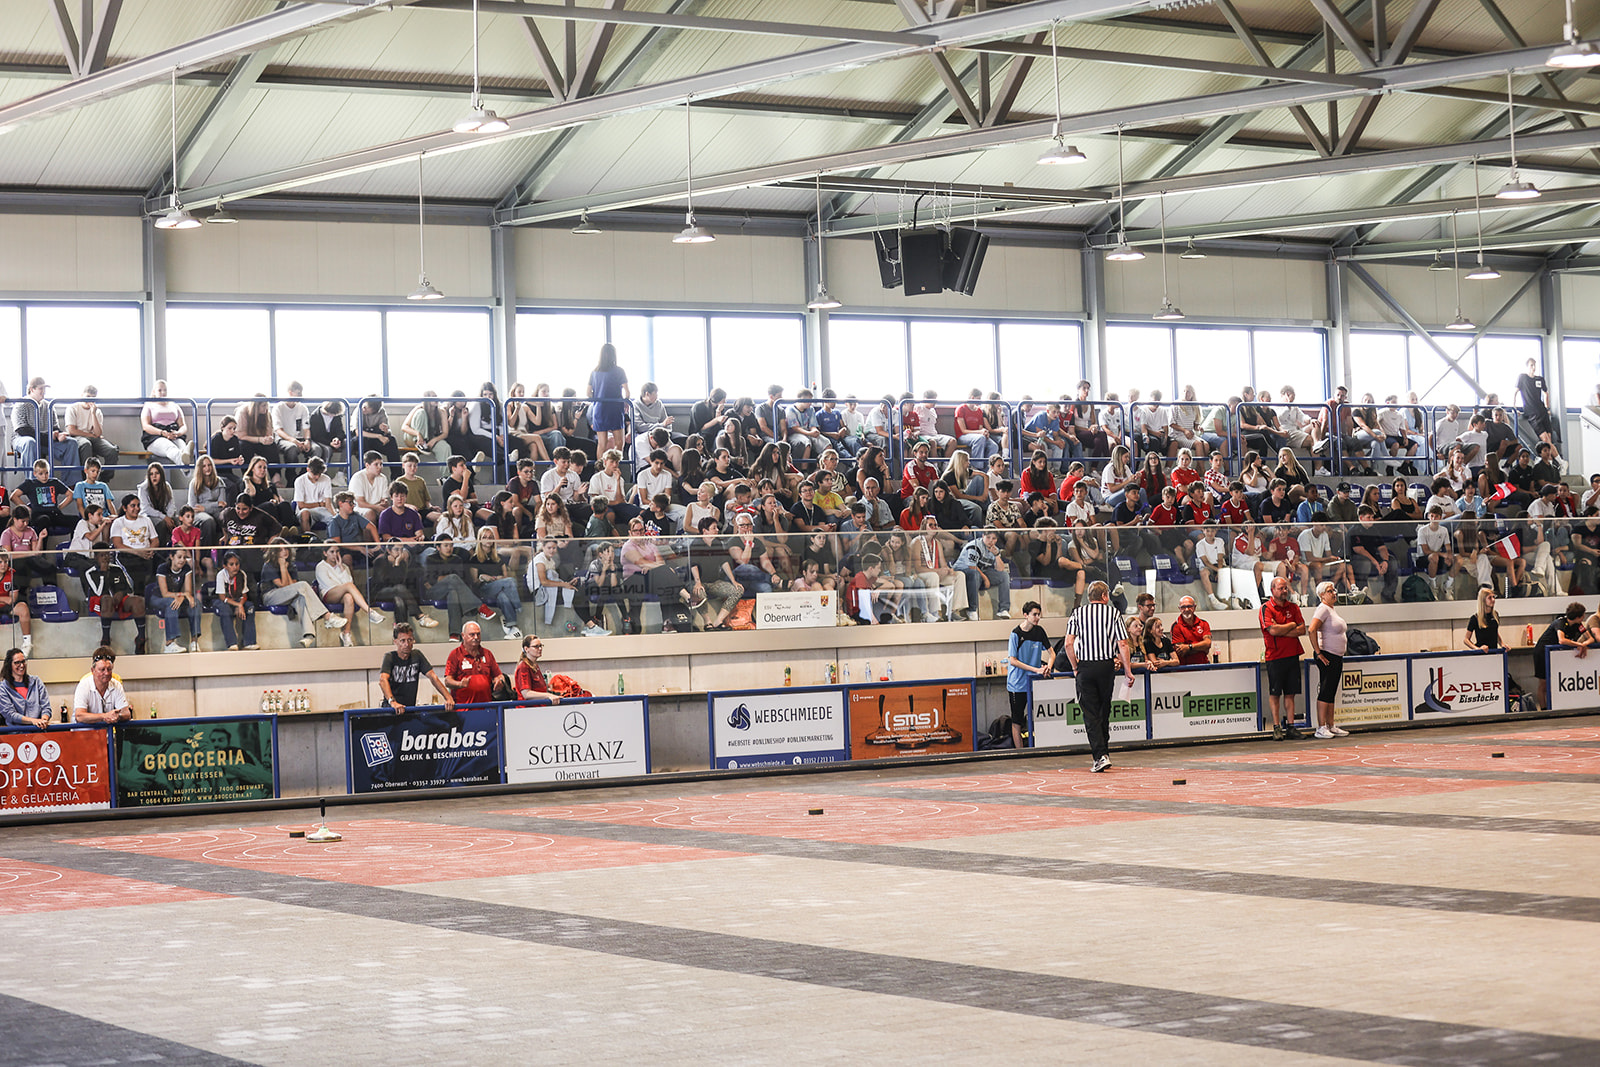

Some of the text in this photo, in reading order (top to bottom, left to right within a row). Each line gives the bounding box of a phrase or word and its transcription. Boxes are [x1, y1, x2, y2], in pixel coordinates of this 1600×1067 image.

[764, 613, 802, 623] Oberwart
[1344, 674, 1360, 687] RM
[1363, 678, 1395, 689] concept
[1558, 670, 1597, 692] kabel
[1154, 695, 1181, 710] ALU
[1188, 696, 1251, 713] PFEIFFER
[754, 706, 833, 724] WEBSCHMIEDE
[1036, 703, 1064, 718] ALU
[1073, 703, 1140, 721] PFER
[400, 727, 487, 752] barabas
[728, 734, 834, 747] #WEBSITE #ONLINESHOP #ONLINEMARKETING
[144, 749, 245, 770] GROCCERIA
[433, 749, 488, 759] BESCHRIFTUNGEN
[528, 740, 624, 765] SCHRANZ
[168, 771, 223, 781] DELIKATESSEN
[555, 769, 600, 781] Oberwart
[11, 795, 18, 804] &
[22, 792, 80, 804] GELATERIA
[140, 789, 167, 797] CENTRALE
[174, 787, 207, 795] HAUPTPLATZ
